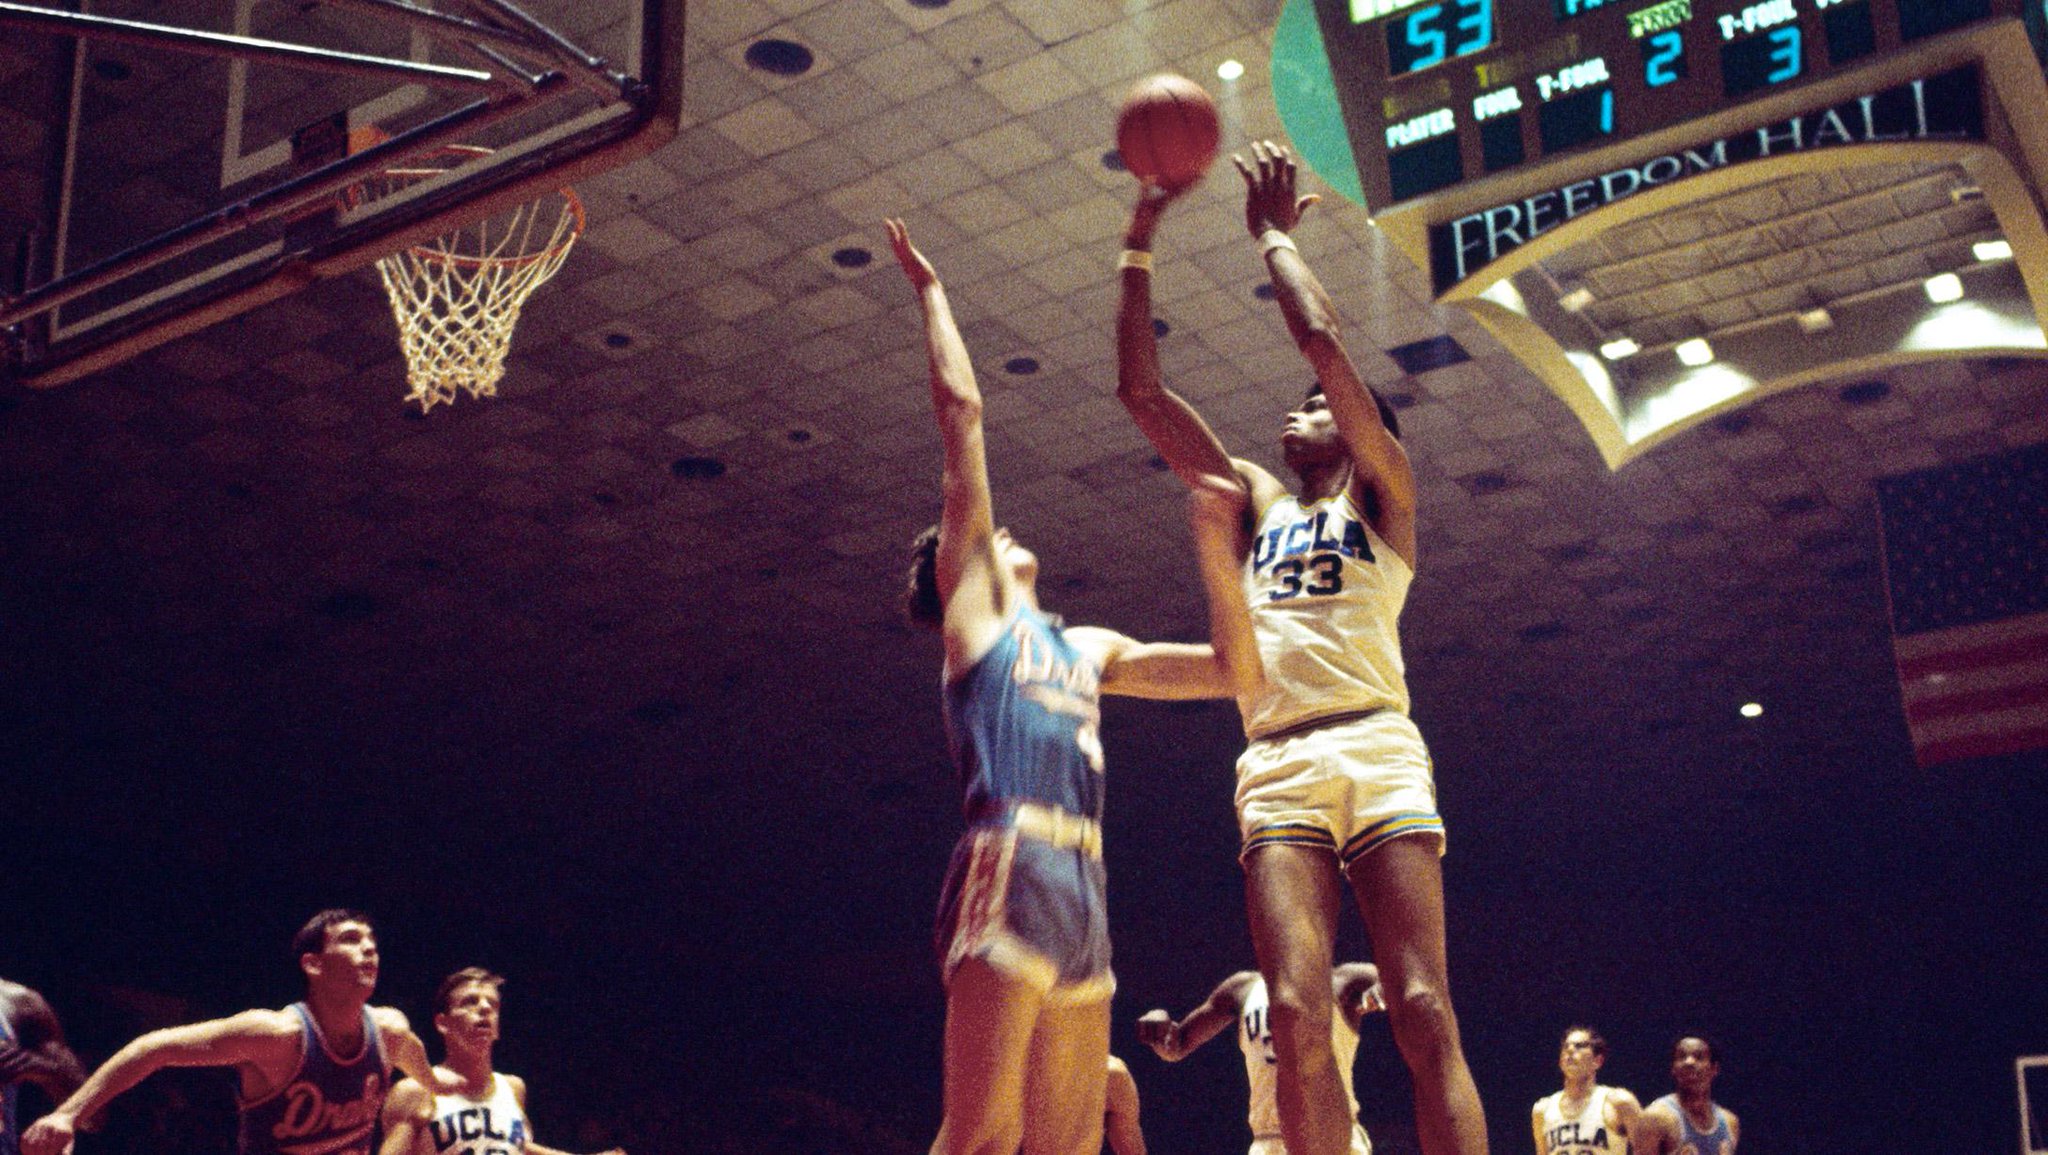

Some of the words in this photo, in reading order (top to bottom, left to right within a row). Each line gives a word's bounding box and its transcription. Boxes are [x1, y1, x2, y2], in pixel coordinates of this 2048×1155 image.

[1405, 0, 1493, 72] 53
[1645, 30, 1683, 87] 2
[1767, 25, 1802, 83] 3
[1536, 57, 1610, 101] T-FOUL
[1473, 86, 1522, 121] FOUL
[1600, 89, 1614, 134] 1
[1385, 108, 1456, 149] PLAYER
[1452, 138, 1728, 281] FREEDOM
[1757, 79, 1968, 157] HALL
[1252, 512, 1376, 573] UCLA
[1269, 553, 1343, 601] 33
[430, 1107, 526, 1152] UCLA
